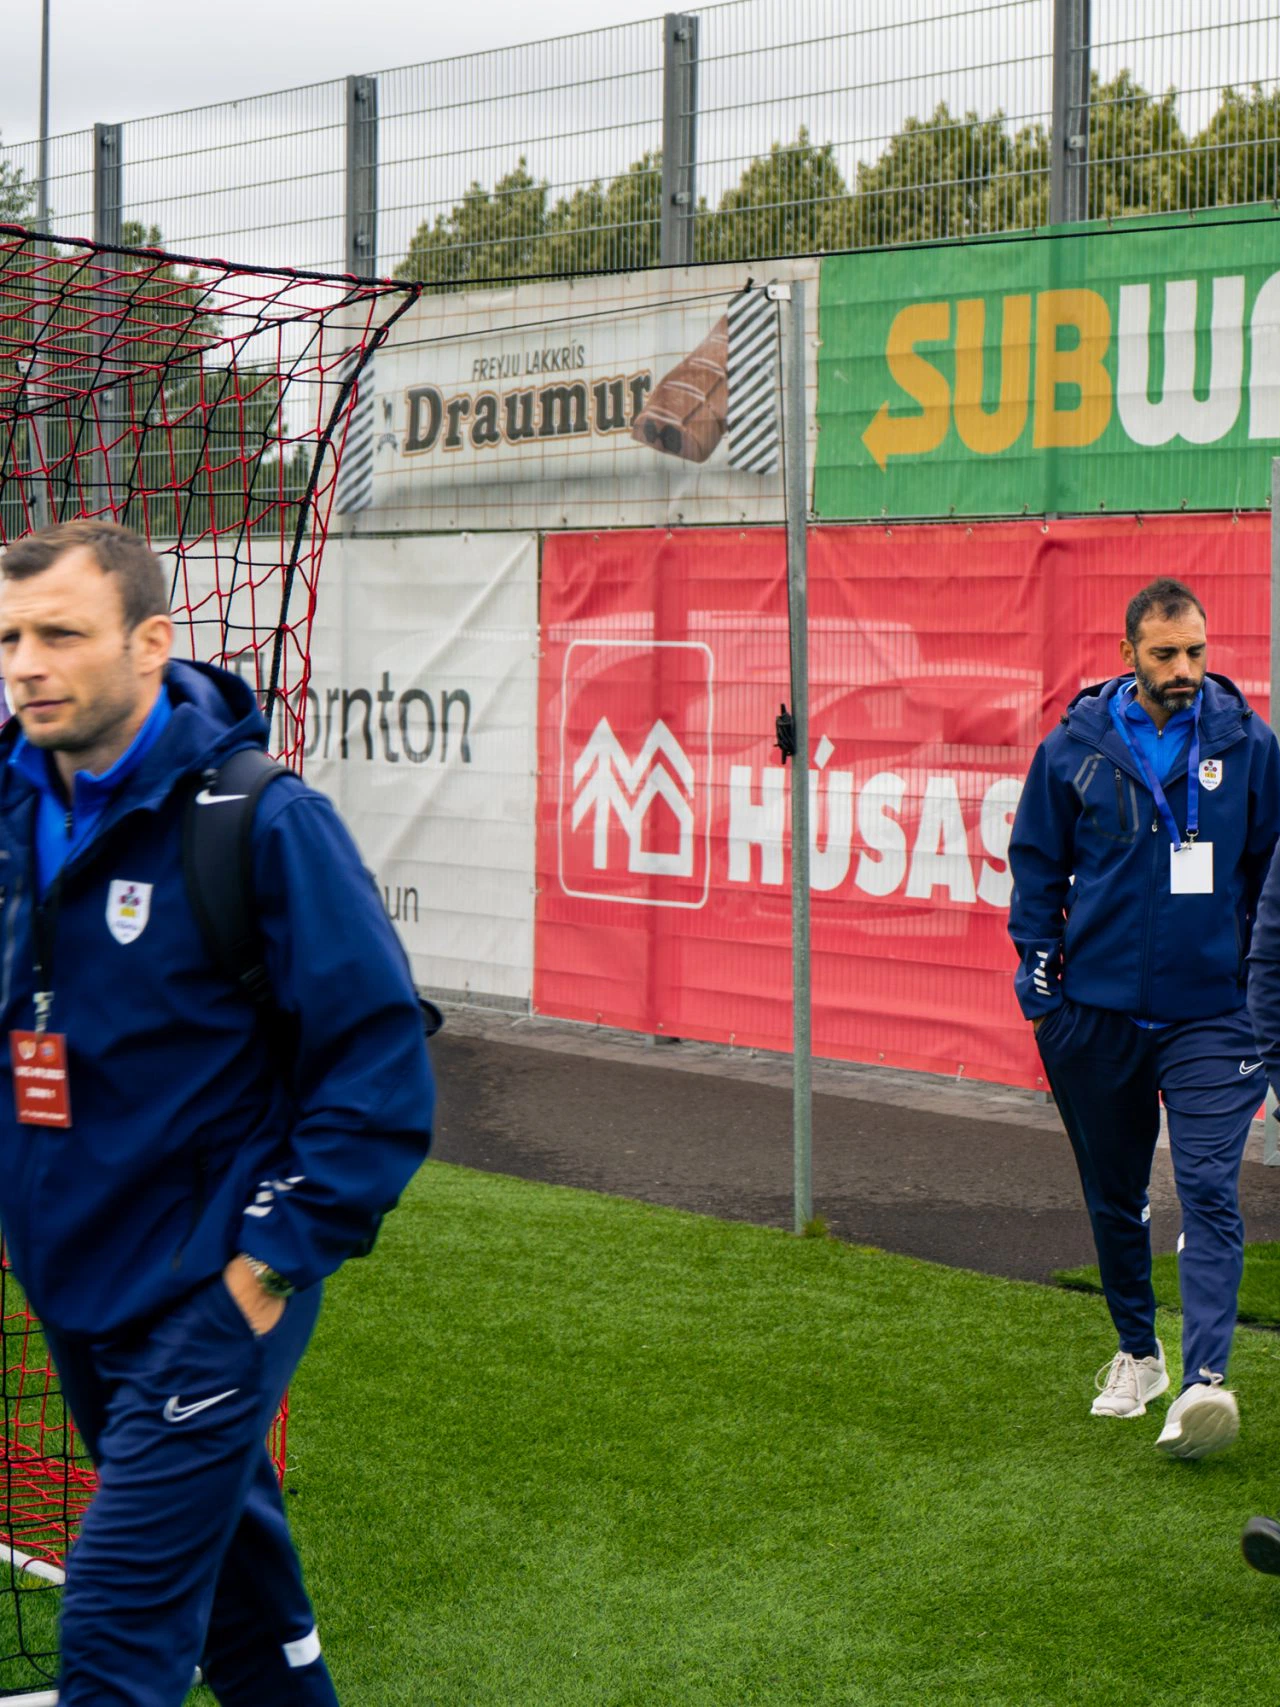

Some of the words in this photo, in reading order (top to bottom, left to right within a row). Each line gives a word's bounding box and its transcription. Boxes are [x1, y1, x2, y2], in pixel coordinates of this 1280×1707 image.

[472, 354, 520, 382] FREYJU
[526, 339, 584, 375] LAKKRÍS
[403, 371, 652, 453] Draumur
